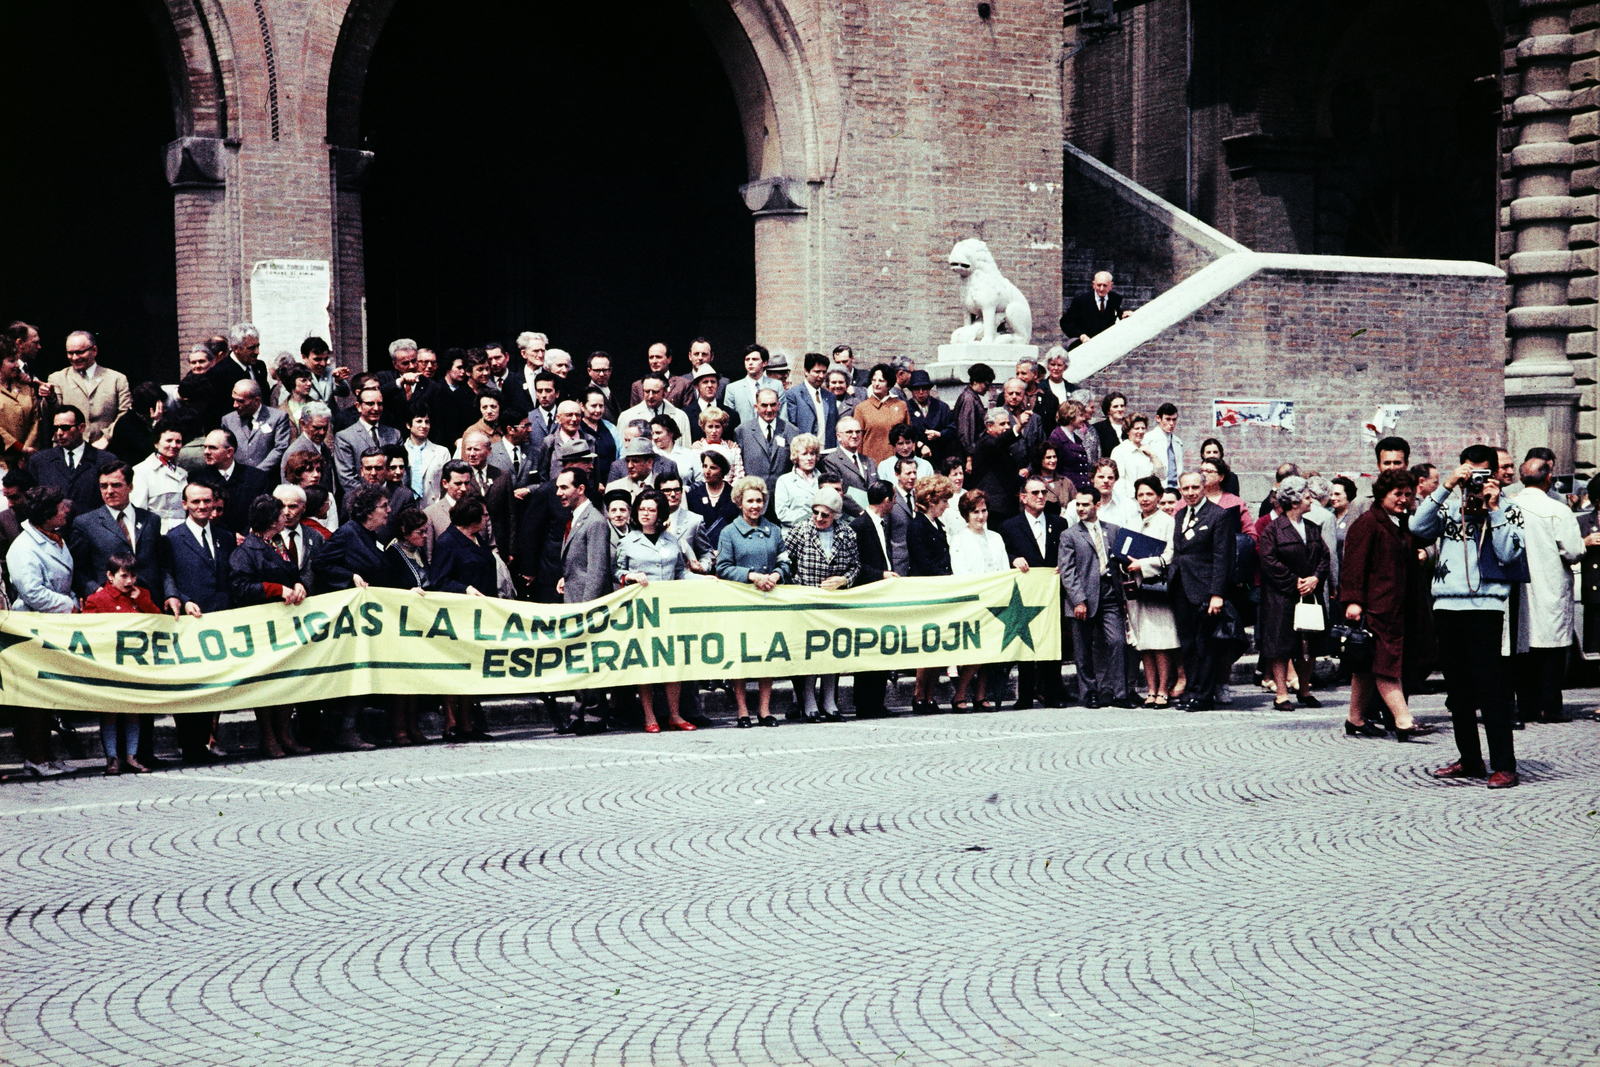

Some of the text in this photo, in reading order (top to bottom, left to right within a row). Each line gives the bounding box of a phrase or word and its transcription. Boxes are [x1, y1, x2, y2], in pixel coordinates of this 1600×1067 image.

[115, 624, 255, 665] RELOJ
[266, 602, 384, 652] LIGAS
[399, 605, 458, 640] LA
[473, 597, 660, 641] LANDOJN
[482, 620, 982, 678] ESPERANTO, LA POPOLOJN
